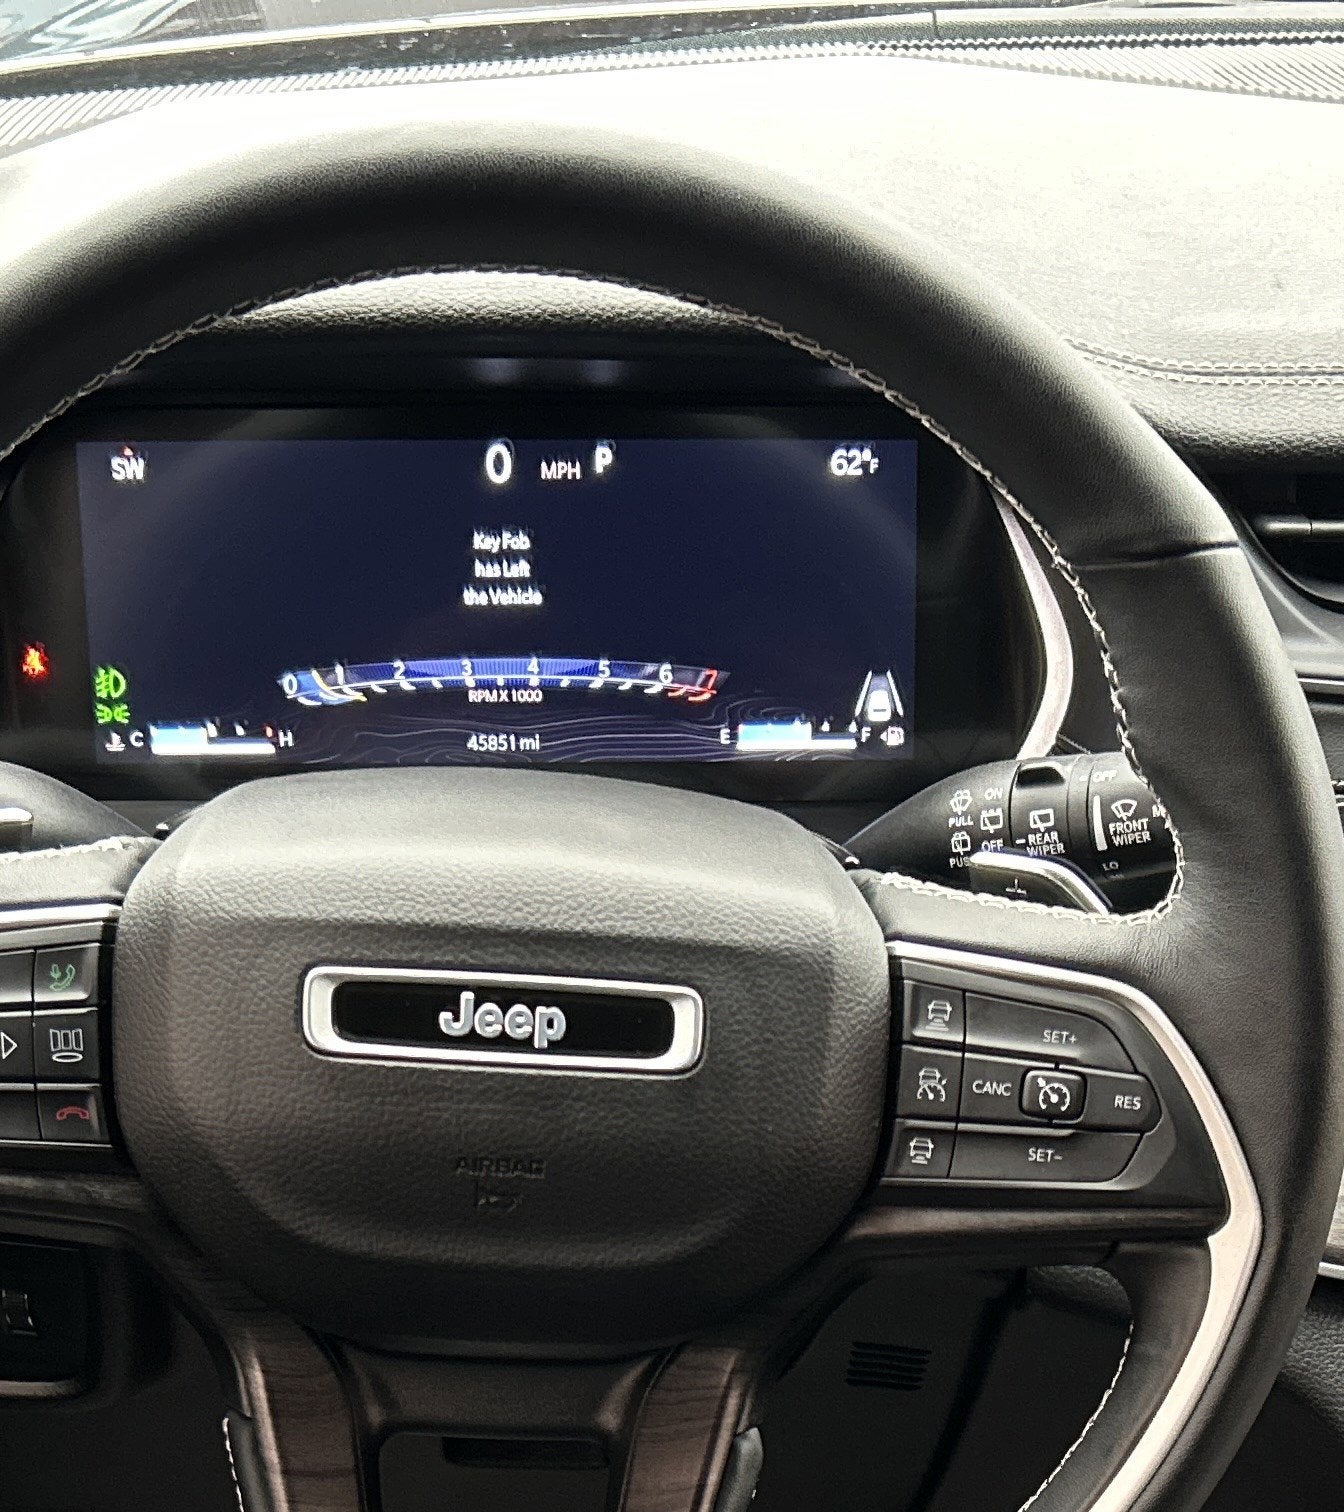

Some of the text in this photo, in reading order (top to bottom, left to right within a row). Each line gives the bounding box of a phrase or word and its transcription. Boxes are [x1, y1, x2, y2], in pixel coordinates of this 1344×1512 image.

[484, 442, 581, 485] 0 MPH
[595, 445, 613, 474] P
[111, 456, 145, 481] SW
[473, 530, 530, 553] Key Fob
[475, 559, 531, 578] has Left
[463, 588, 543, 606] the Vehicle
[393, 661, 406, 680] 2
[461, 659, 473, 676] 3
[527, 658, 539, 676] 4
[599, 659, 611, 676] 5
[658, 664, 673, 685] 6
[284, 676, 298, 694] 0
[468, 689, 543, 703] RPM X 1000
[129, 731, 144, 748] C
[279, 731, 294, 748] H
[467, 734, 540, 752] 45851 mi
[720, 728, 730, 745] E
[861, 727, 871, 743] F
[1092, 770, 1118, 783] OFF
[984, 788, 1003, 800] ON
[948, 816, 974, 828] PULL
[1108, 818, 1149, 835] FRONT
[981, 839, 1004, 852] OFF
[1027, 831, 1060, 845] REAR
[1111, 831, 1152, 847] WIPER
[1026, 843, 1066, 857] WIPER
[438, 991, 567, 1049] Jeep
[972, 1079, 1012, 1097] CANC
[1114, 1094, 1141, 1111] RES
